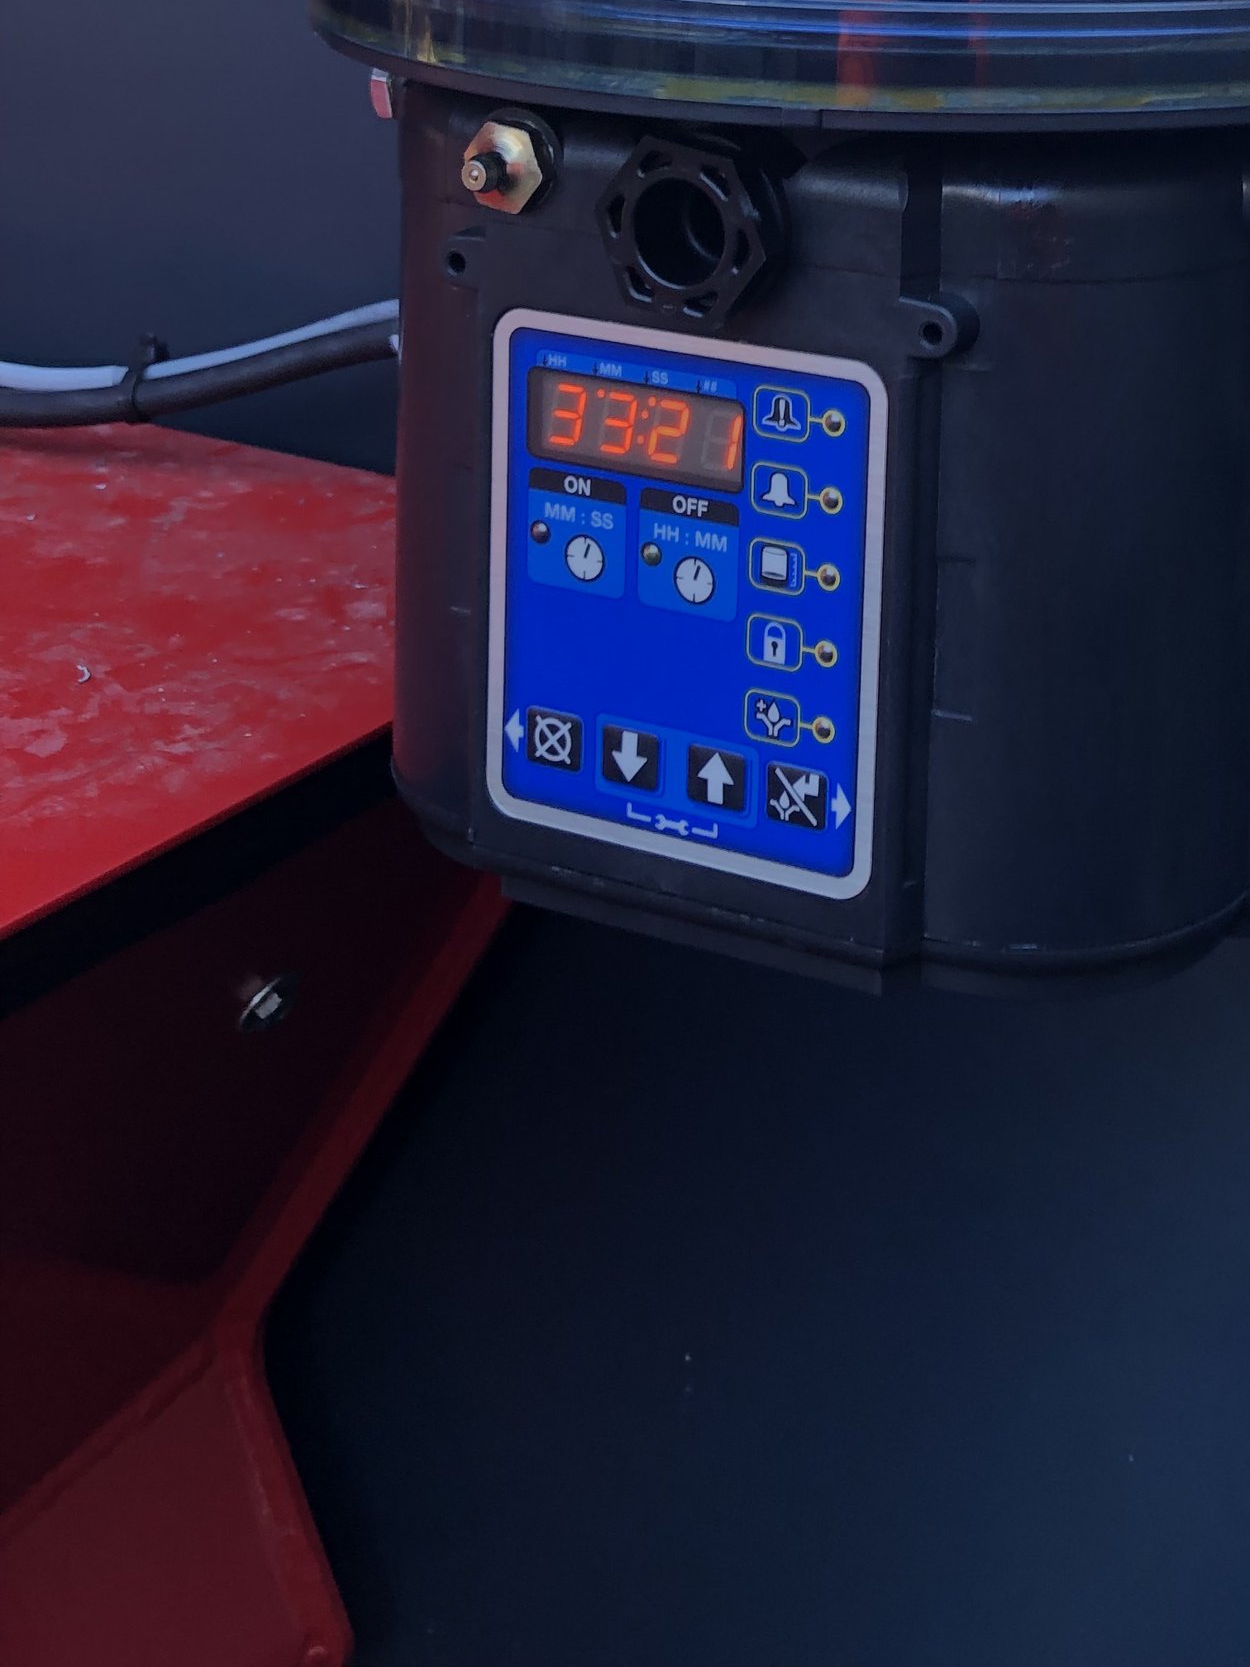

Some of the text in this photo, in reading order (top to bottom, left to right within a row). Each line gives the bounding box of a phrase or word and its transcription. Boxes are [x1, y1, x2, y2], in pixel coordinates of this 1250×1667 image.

[548, 354, 567, 368] HH
[599, 362, 622, 377] MM
[652, 370, 669, 384] SS
[563, 475, 591, 497] ON
[544, 502, 576, 523] MM
[590, 510, 614, 530] SS
[672, 495, 709, 518] OFF
[653, 522, 679, 543] HH
[694, 530, 727, 553] MM
